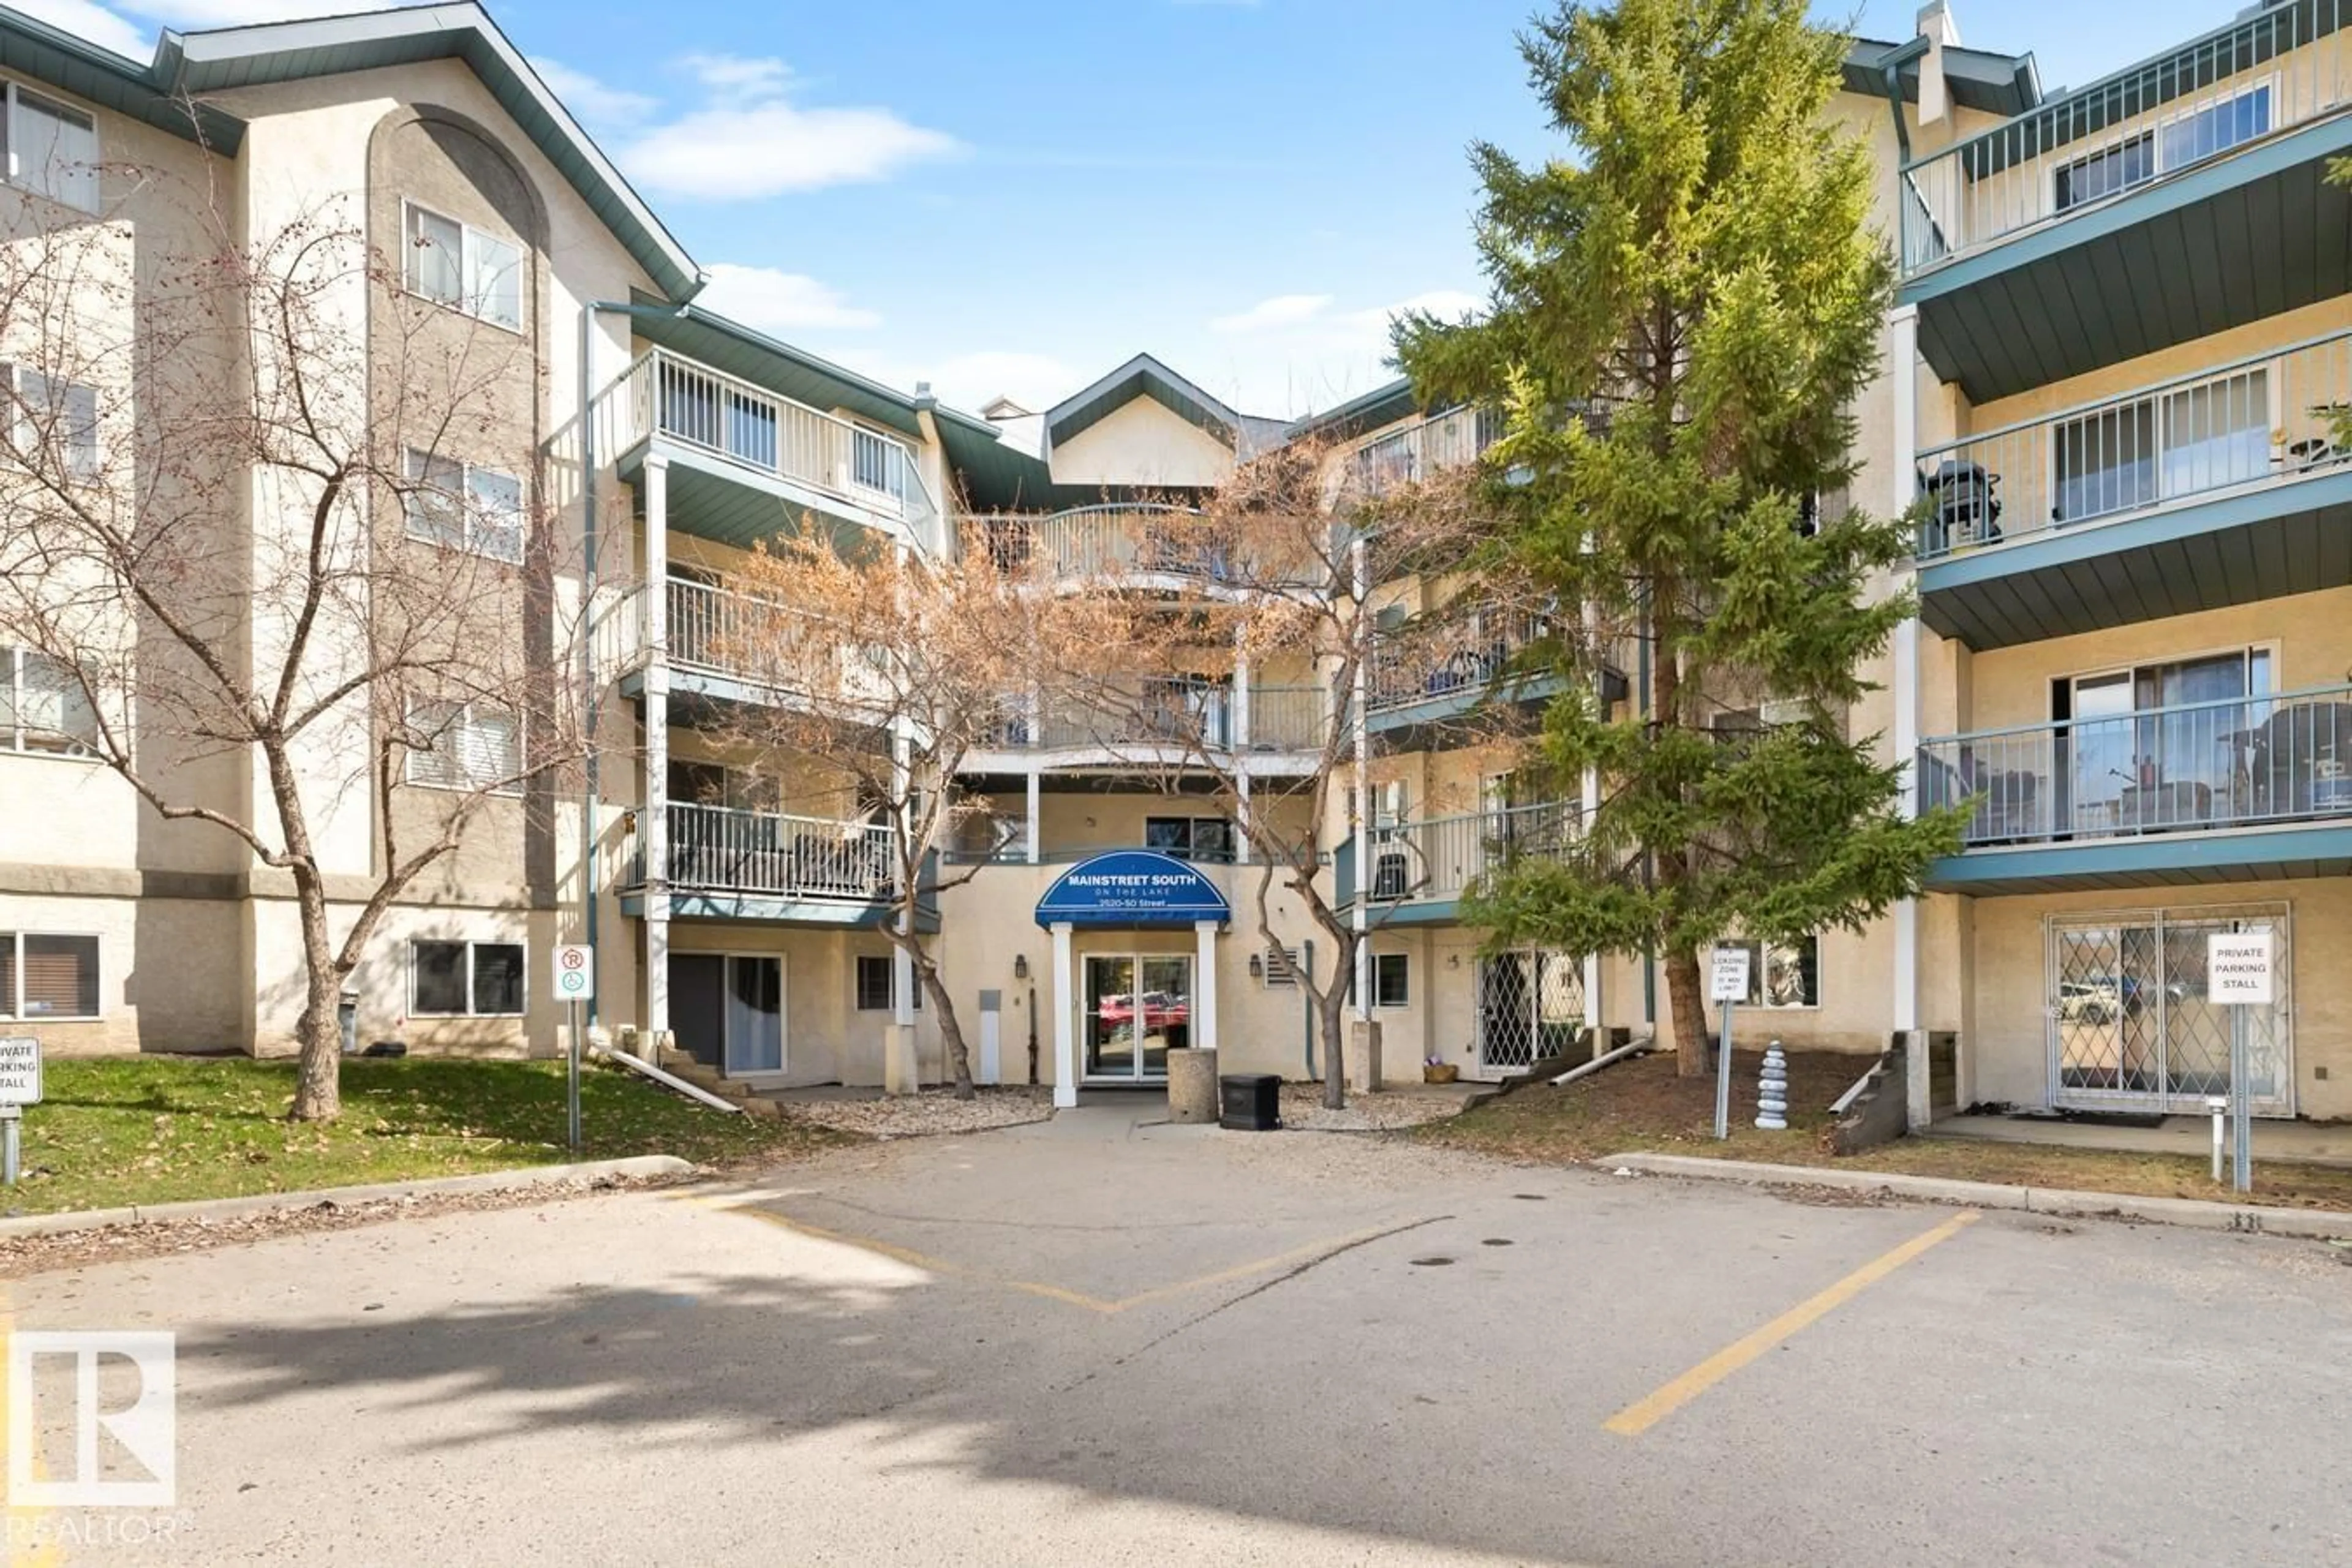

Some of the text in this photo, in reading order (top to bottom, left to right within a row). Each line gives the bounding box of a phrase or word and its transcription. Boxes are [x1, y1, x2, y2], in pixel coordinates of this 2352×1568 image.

[1069, 874, 1196, 886] MAINSTREET SOUTH
[1139, 899, 1166, 907] Street
[2217, 948, 2265, 958] PRIVATE
[2215, 963, 2266, 973] PARKING
[2222, 979, 2259, 989] STALL
[0, 1046, 32, 1057] IVATE
